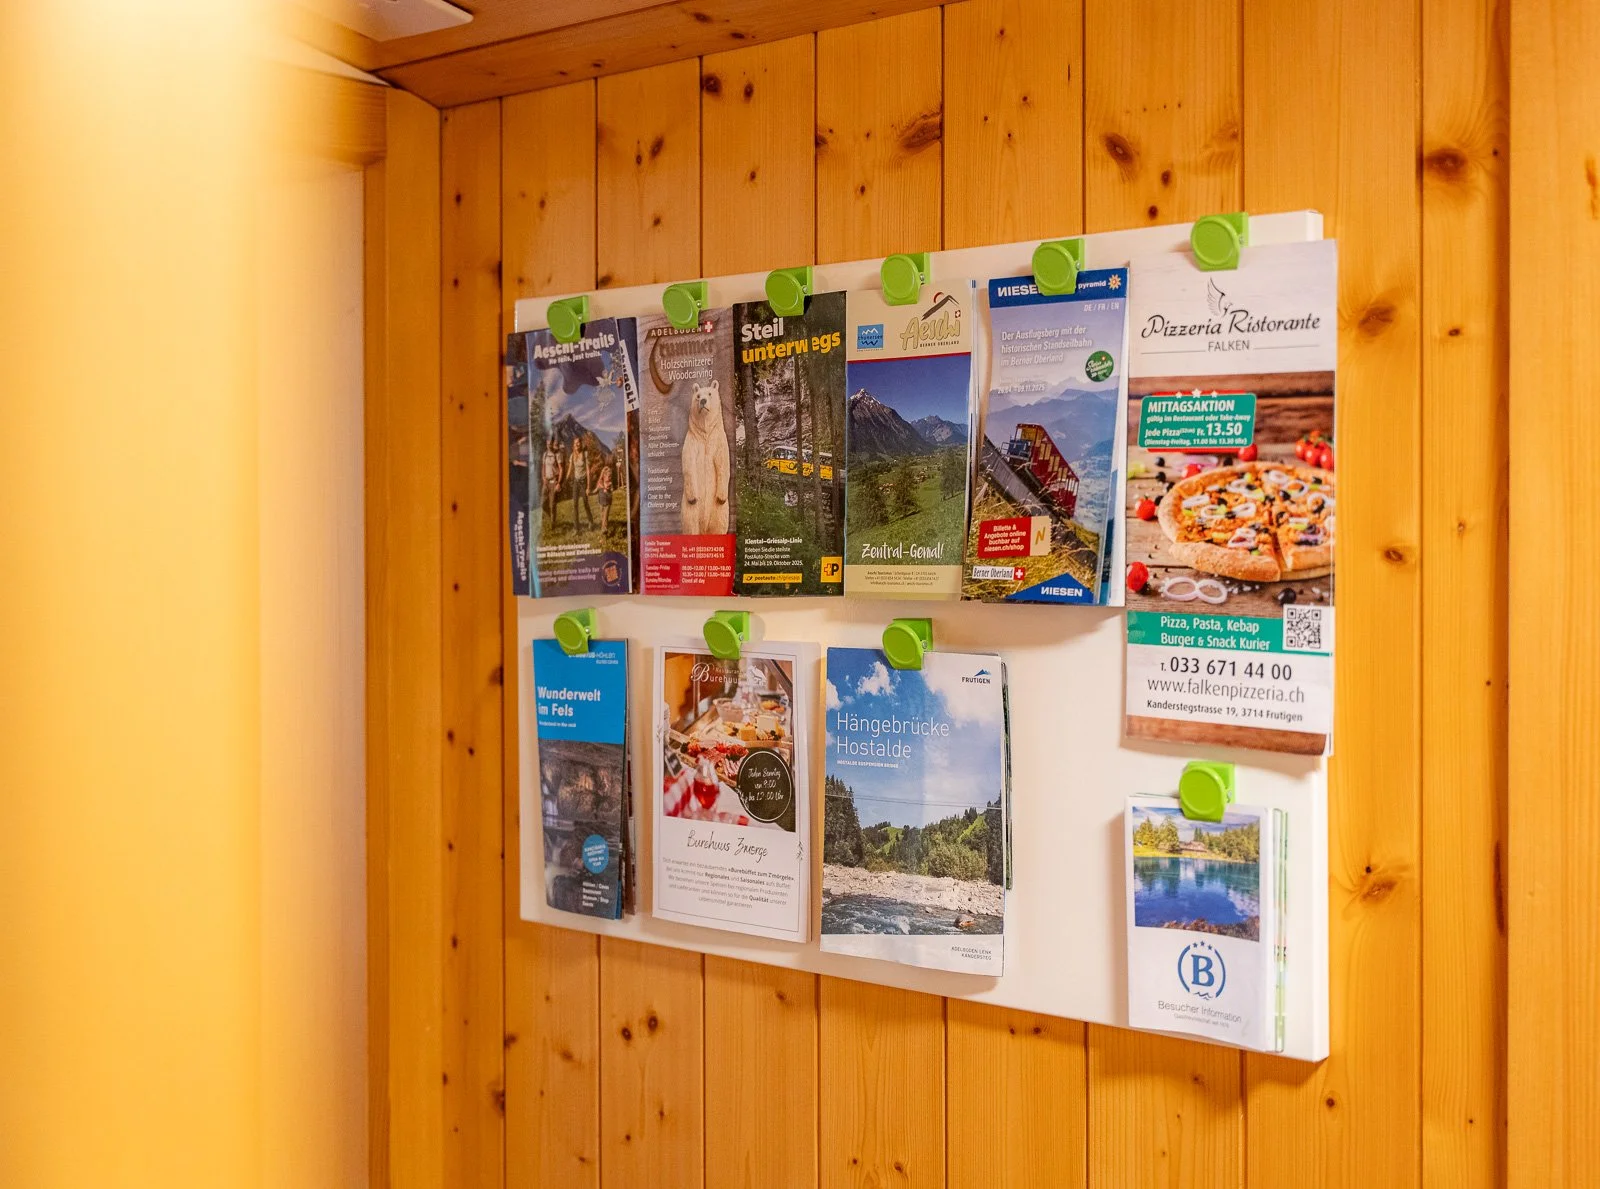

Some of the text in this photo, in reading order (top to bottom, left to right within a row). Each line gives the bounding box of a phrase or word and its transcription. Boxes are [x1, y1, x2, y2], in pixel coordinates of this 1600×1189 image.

[998, 284, 1042, 297] NIESE
[1084, 304, 1092, 312] DE
[741, 317, 784, 342] Steil
[1141, 309, 1321, 338] Pizzeria Ristorante
[1002, 325, 1087, 340] Der Ausflugsberg mit der
[742, 332, 841, 364] unterwegs
[1001, 338, 1093, 354] historischen Standseilbahn
[1208, 340, 1251, 352] FALKEN
[660, 356, 714, 370] Holzschnitzerei
[1010, 356, 1033, 366] Berner
[1034, 353, 1064, 364] Oberland
[669, 368, 713, 380] Woodcarving
[1148, 400, 1235, 413] MITTAGSAKTION
[1145, 429, 1161, 438] Jede
[1206, 422, 1243, 436] 13.50
[984, 544, 1025, 552] niesen.ch/shop
[973, 567, 1013, 578] Berner Oberland
[1041, 586, 1083, 597] NIESEN
[1160, 616, 1260, 634] Pizza, Pasta, Kebap
[1160, 633, 1271, 651] Burger & Snack Kurier
[1160, 656, 1292, 681] T. 033 671 44 00
[961, 676, 991, 685] FRUTIGEN
[537, 686, 601, 701] Wunderwelt
[1147, 678, 1305, 704] www.falkenpizzeria.ch
[538, 703, 574, 716] im Fels
[1147, 700, 1303, 723] Kanderstegstrasse 19, 3714 Frutigen
[837, 712, 950, 738] Hängebrücke
[837, 736, 912, 759] Hostalde
[1191, 954, 1215, 987] B
[1158, 1000, 1199, 1015] Besucher
[1201, 1005, 1242, 1024] Information
